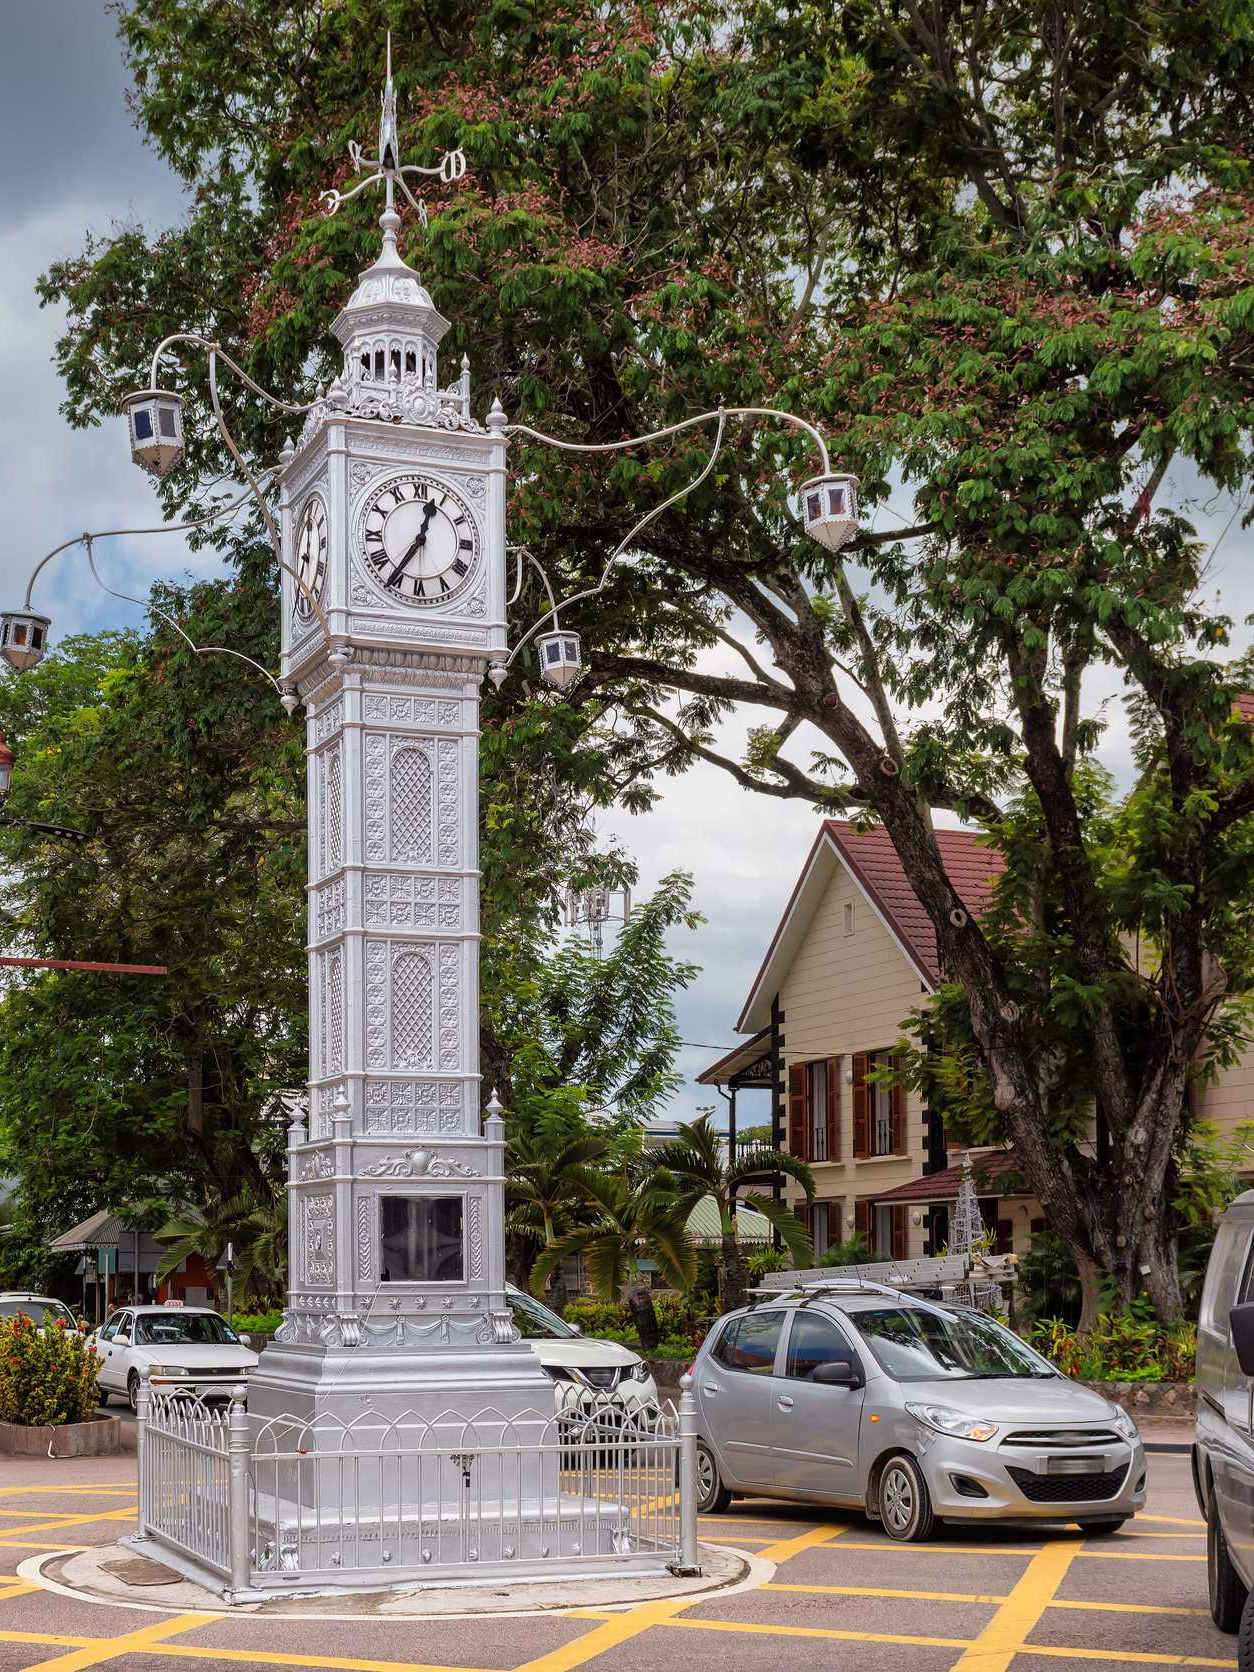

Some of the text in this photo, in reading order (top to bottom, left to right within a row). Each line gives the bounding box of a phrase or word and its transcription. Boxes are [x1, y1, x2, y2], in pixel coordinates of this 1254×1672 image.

[389, 486, 406, 504] XI
[413, 483, 428, 500] XII
[440, 494, 448, 506] I
[372, 504, 388, 520] X
[453, 515, 466, 526] II
[365, 529, 383, 542] IX
[370, 549, 390, 572] VIII
[439, 576, 451, 593] V
